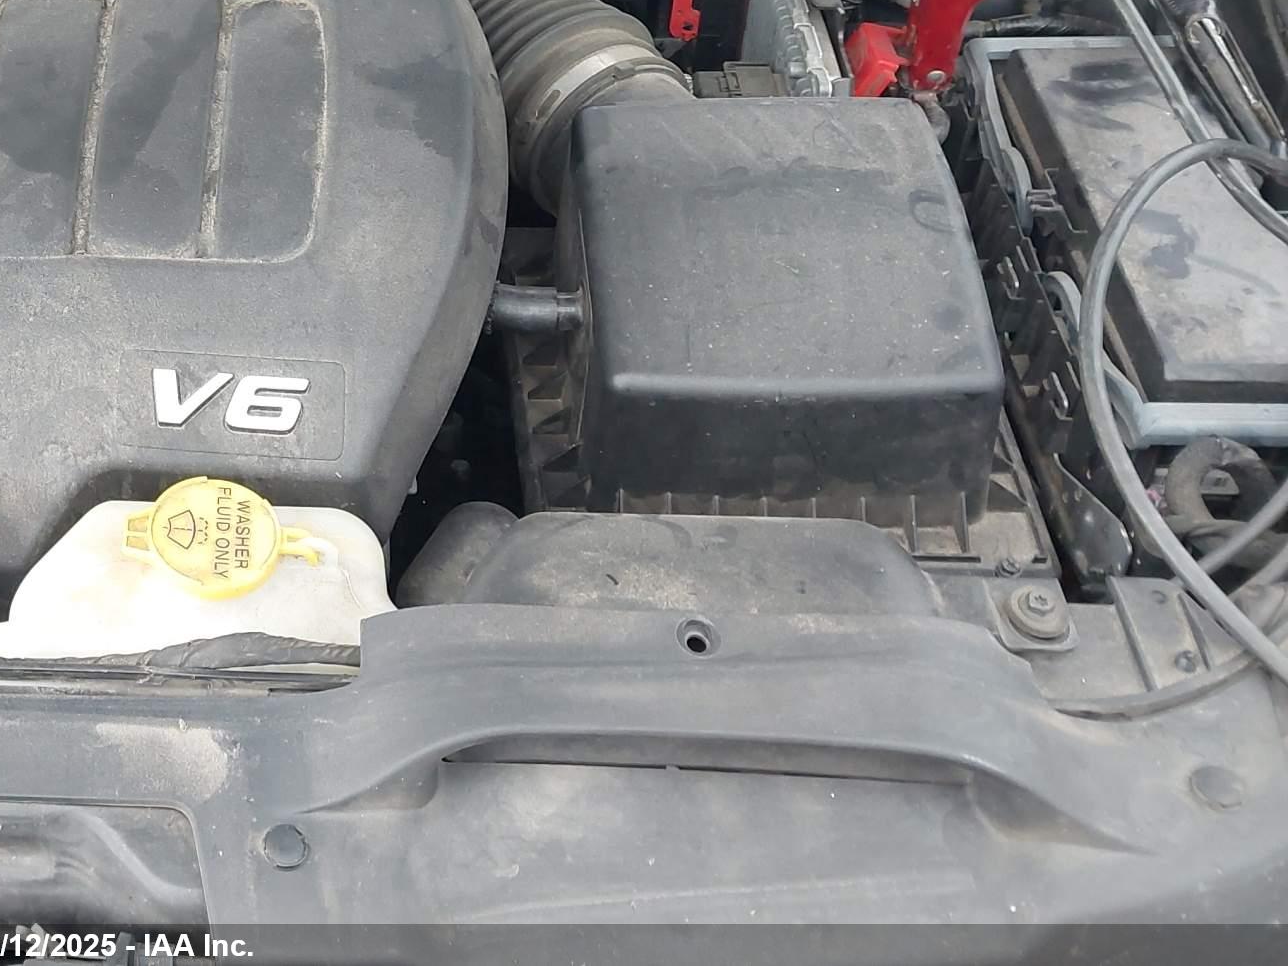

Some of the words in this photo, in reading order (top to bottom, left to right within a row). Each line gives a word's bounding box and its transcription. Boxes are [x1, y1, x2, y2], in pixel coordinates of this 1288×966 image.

[152, 368, 311, 435] V6
[215, 487, 232, 532] FLUID
[234, 500, 251, 570] WASHER
[214, 536, 231, 579] ONLY
